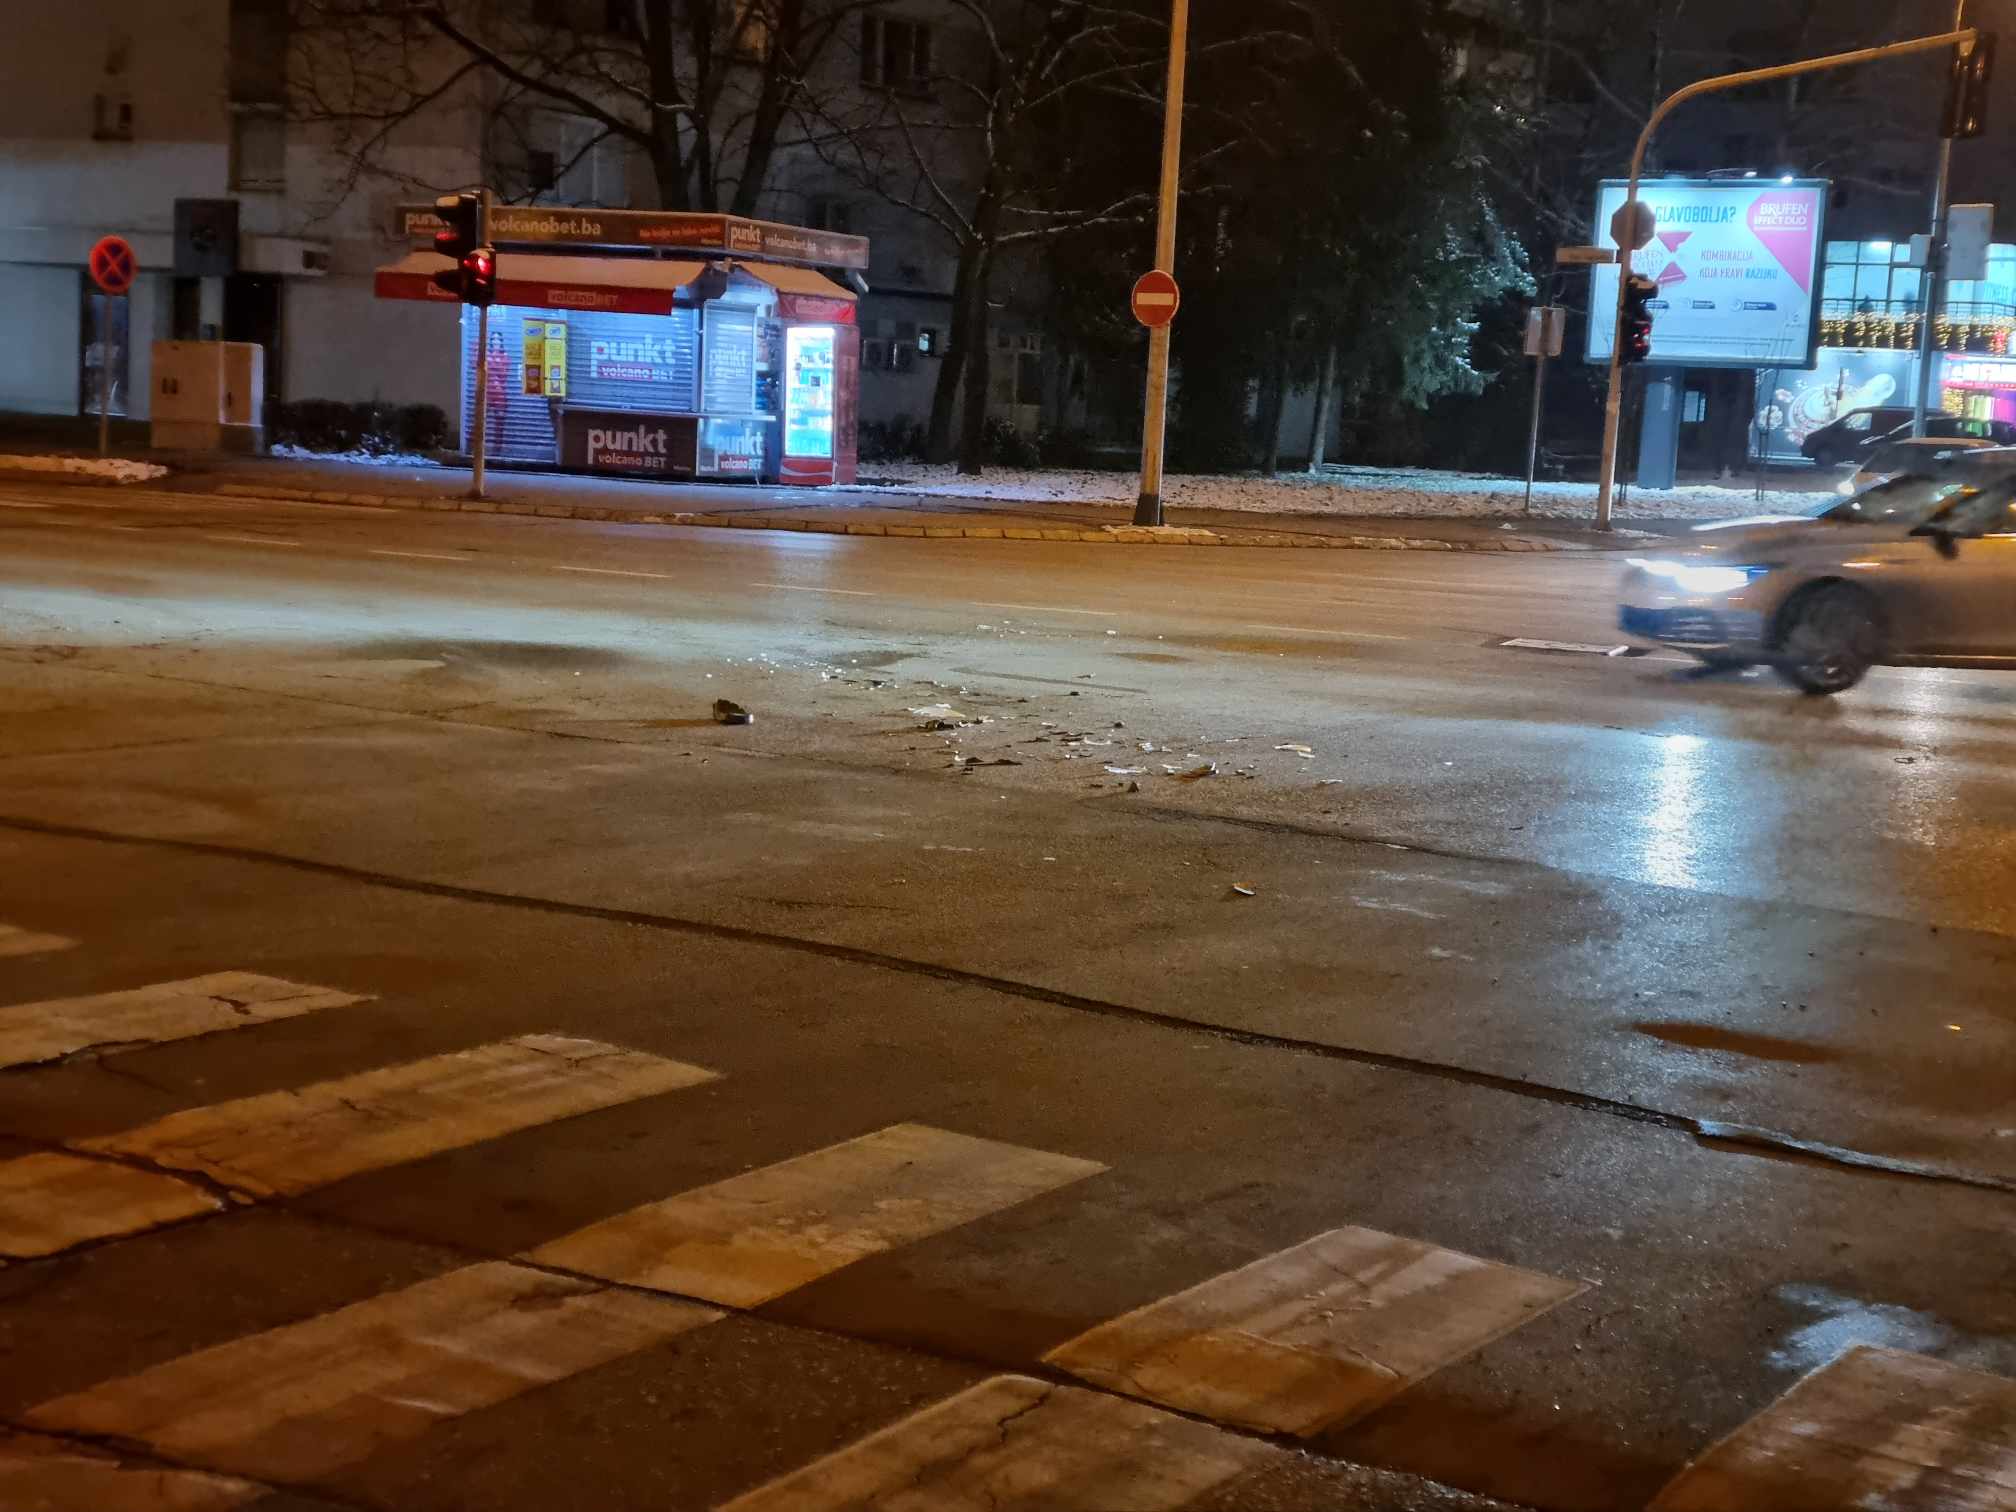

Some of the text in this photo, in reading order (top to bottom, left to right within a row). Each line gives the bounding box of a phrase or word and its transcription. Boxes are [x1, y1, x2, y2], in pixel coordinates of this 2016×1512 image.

[1655, 206, 1737, 223] GLAVOBOLJA?
[1759, 202, 1809, 216] BRUFEN
[490, 212, 601, 236] volcanobet.ba
[730, 224, 761, 248] punkt
[590, 334, 676, 378] punkt
[602, 364, 651, 379] volcano
[587, 424, 667, 465] punkt
[713, 427, 764, 472] punkt
[598, 452, 667, 468] volcano BET
[719, 455, 749, 470] volcano
